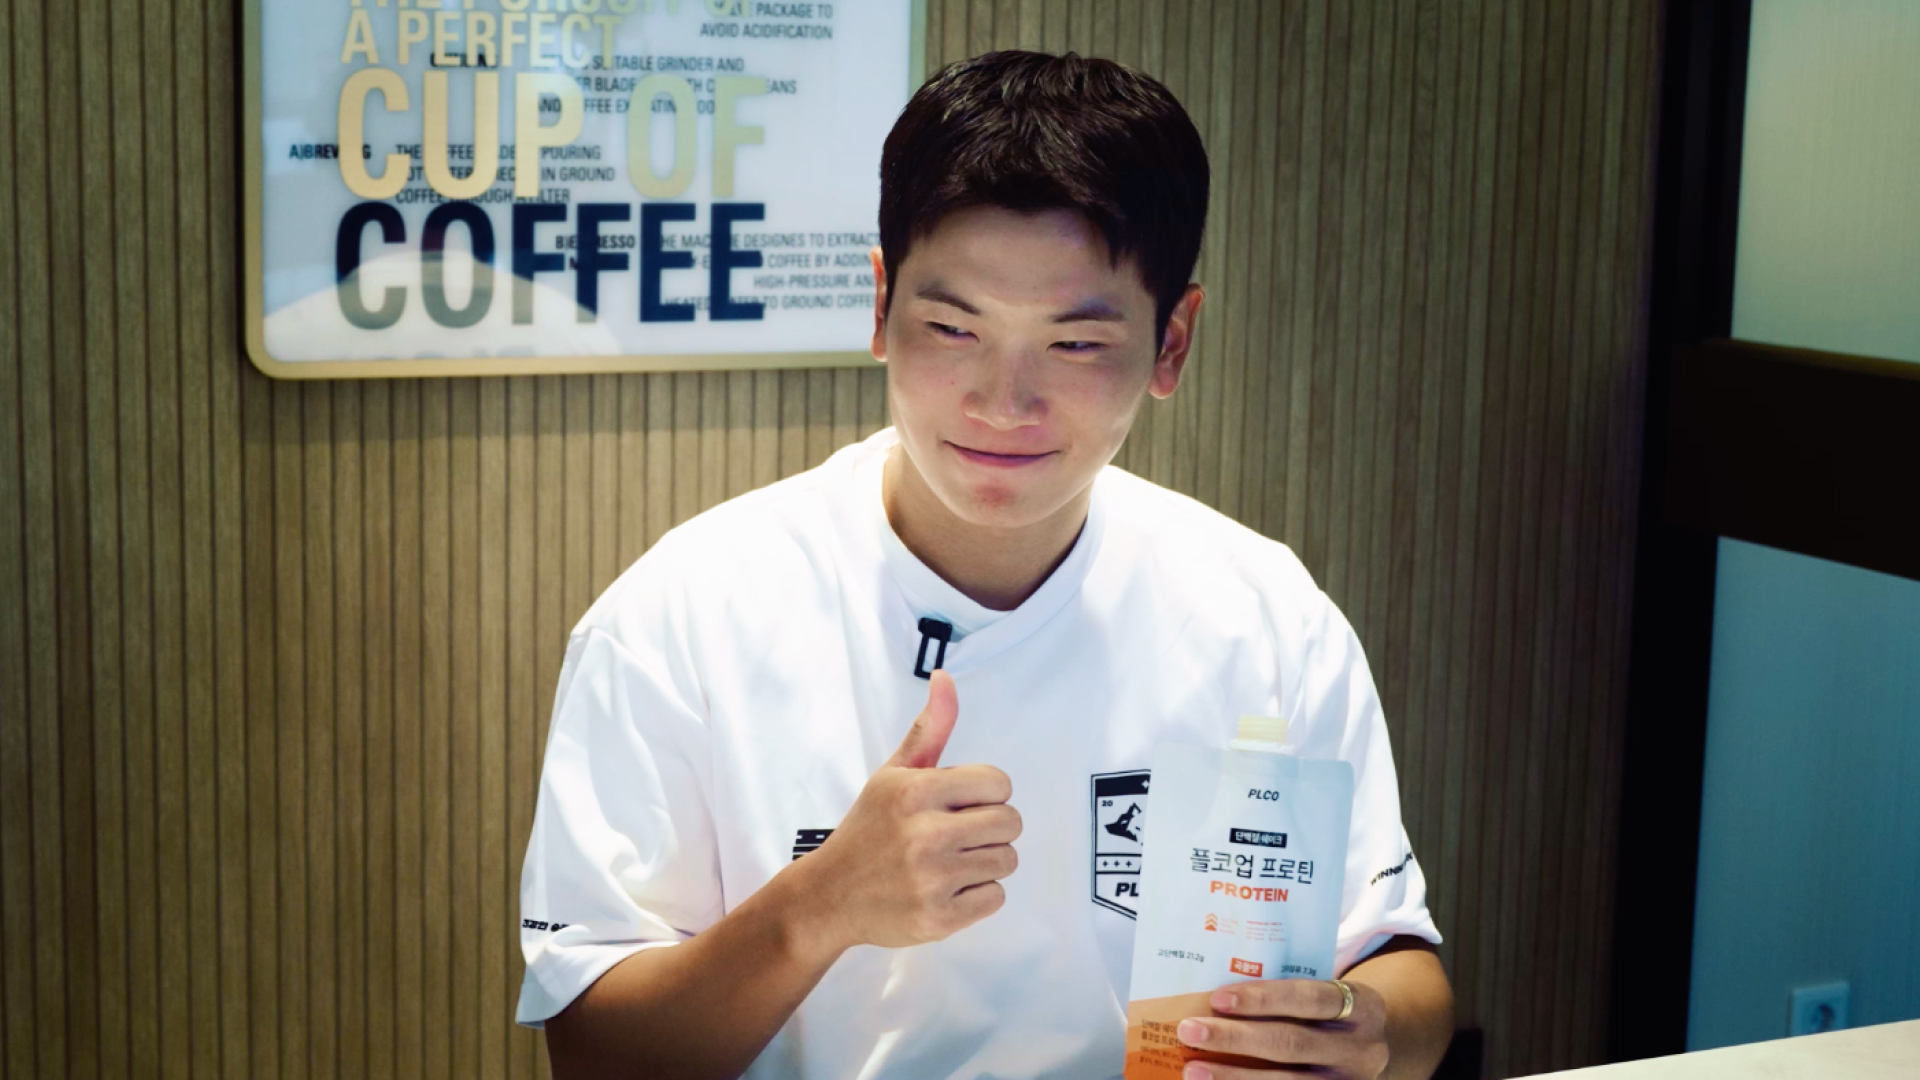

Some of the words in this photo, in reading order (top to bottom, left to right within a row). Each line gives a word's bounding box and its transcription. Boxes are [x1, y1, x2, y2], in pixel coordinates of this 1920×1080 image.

[756, 3, 813, 18] PACKAGE
[818, 4, 834, 18] TO
[341, 8, 379, 64] A
[397, 10, 623, 68] PERFECT
[700, 22, 739, 38] AVOID
[743, 23, 833, 39] ACIDIFICATION
[657, 57, 714, 71] GRINDER
[716, 57, 745, 72] AND
[337, 67, 583, 199] CUP
[627, 73, 767, 199] OF
[541, 145, 601, 160] POURING
[541, 166, 556, 181] IN
[559, 166, 615, 182] GROUND
[744, 232, 804, 248] DESIGNES
[809, 232, 824, 247] TO
[335, 202, 766, 331] COFFEE
[768, 252, 810, 268] COFFEE
[814, 252, 831, 267] BY
[834, 251, 871, 267] ADDIN
[754, 273, 850, 289] HIGH-PRESSURE
[782, 294, 833, 310] GROUND
[1248, 788, 1280, 802] PLCO
[1190, 847, 1255, 880] 플코업
[1259, 857, 1315, 885] 프로틴
[1115, 882, 1140, 897] PL
[1209, 879, 1289, 902] PROTEIN
